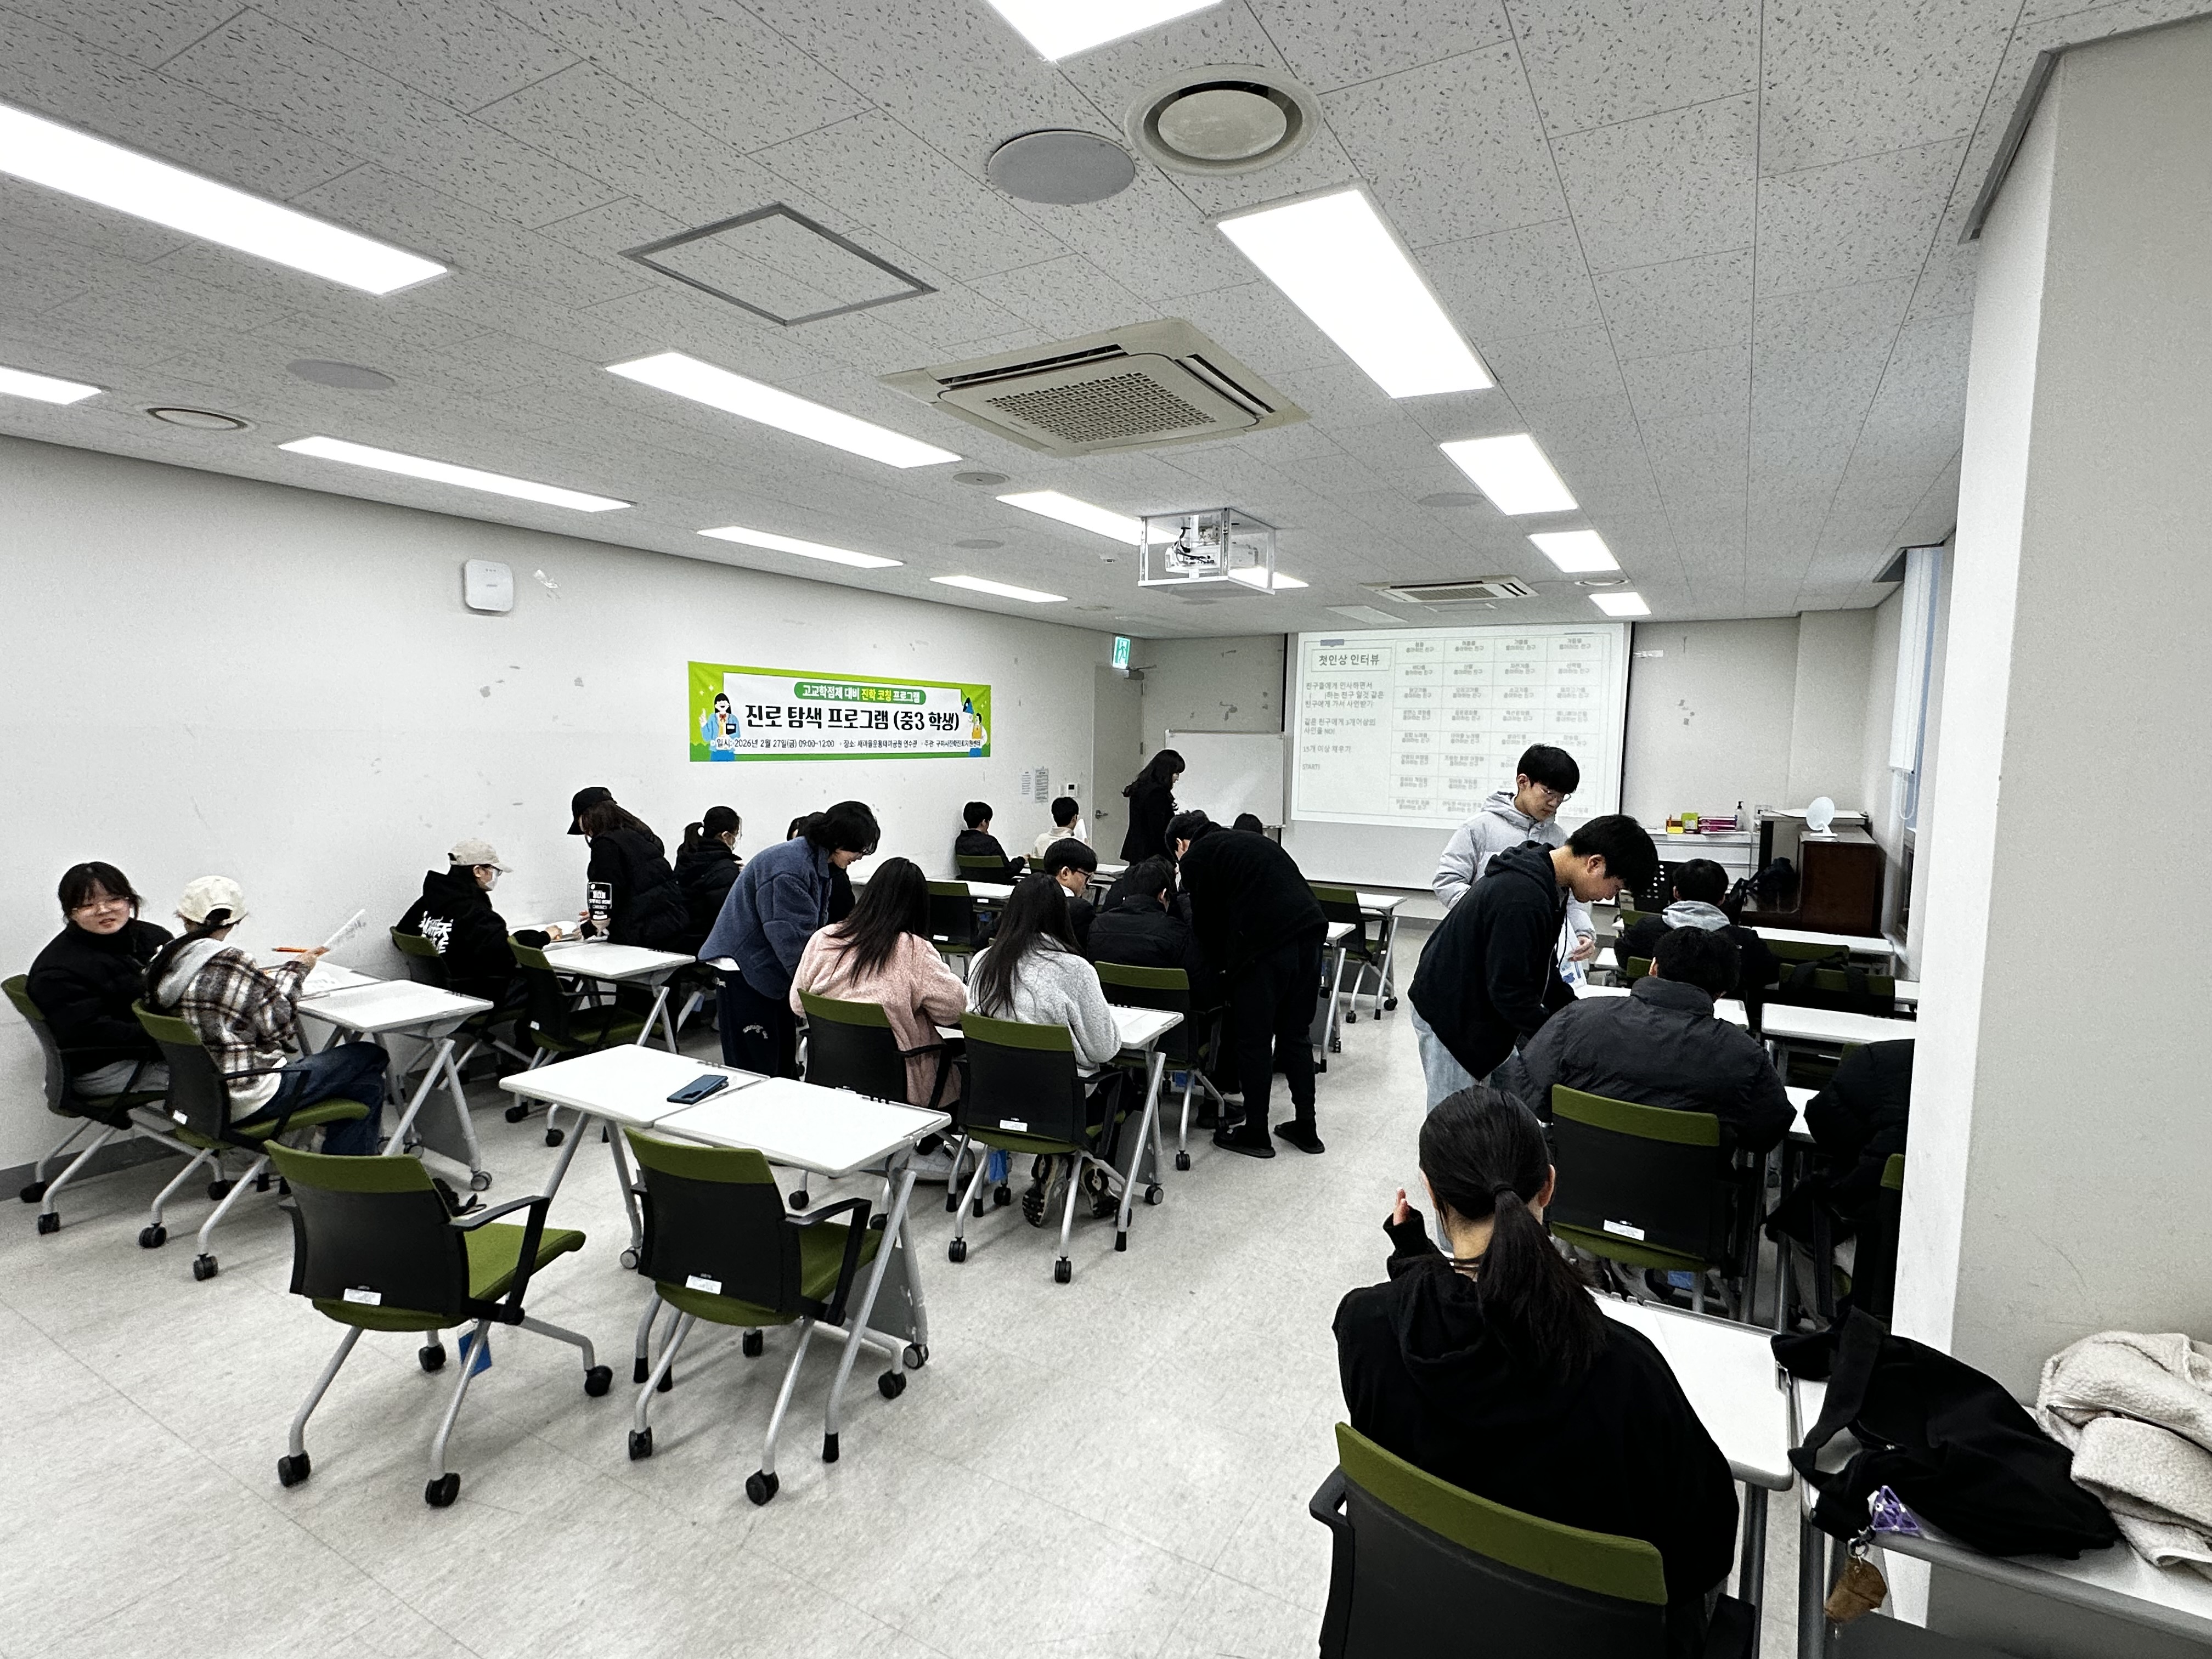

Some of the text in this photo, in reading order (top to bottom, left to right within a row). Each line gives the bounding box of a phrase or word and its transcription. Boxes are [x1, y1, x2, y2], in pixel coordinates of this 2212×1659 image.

[1319, 654, 1380, 666] 첫인상 인터뷰
[802, 685, 920, 703] 고교학점제 대비 진학 코칭 프로그램
[746, 704, 960, 731] 진로 탐색 프로그램 (중3 학생)
[716, 740, 732, 748] 일시:
[735, 740, 758, 748] 2026년
[760, 740, 771, 748] 2월
[773, 739, 797, 748] 27일(금)
[843, 740, 856, 748] 장소:
